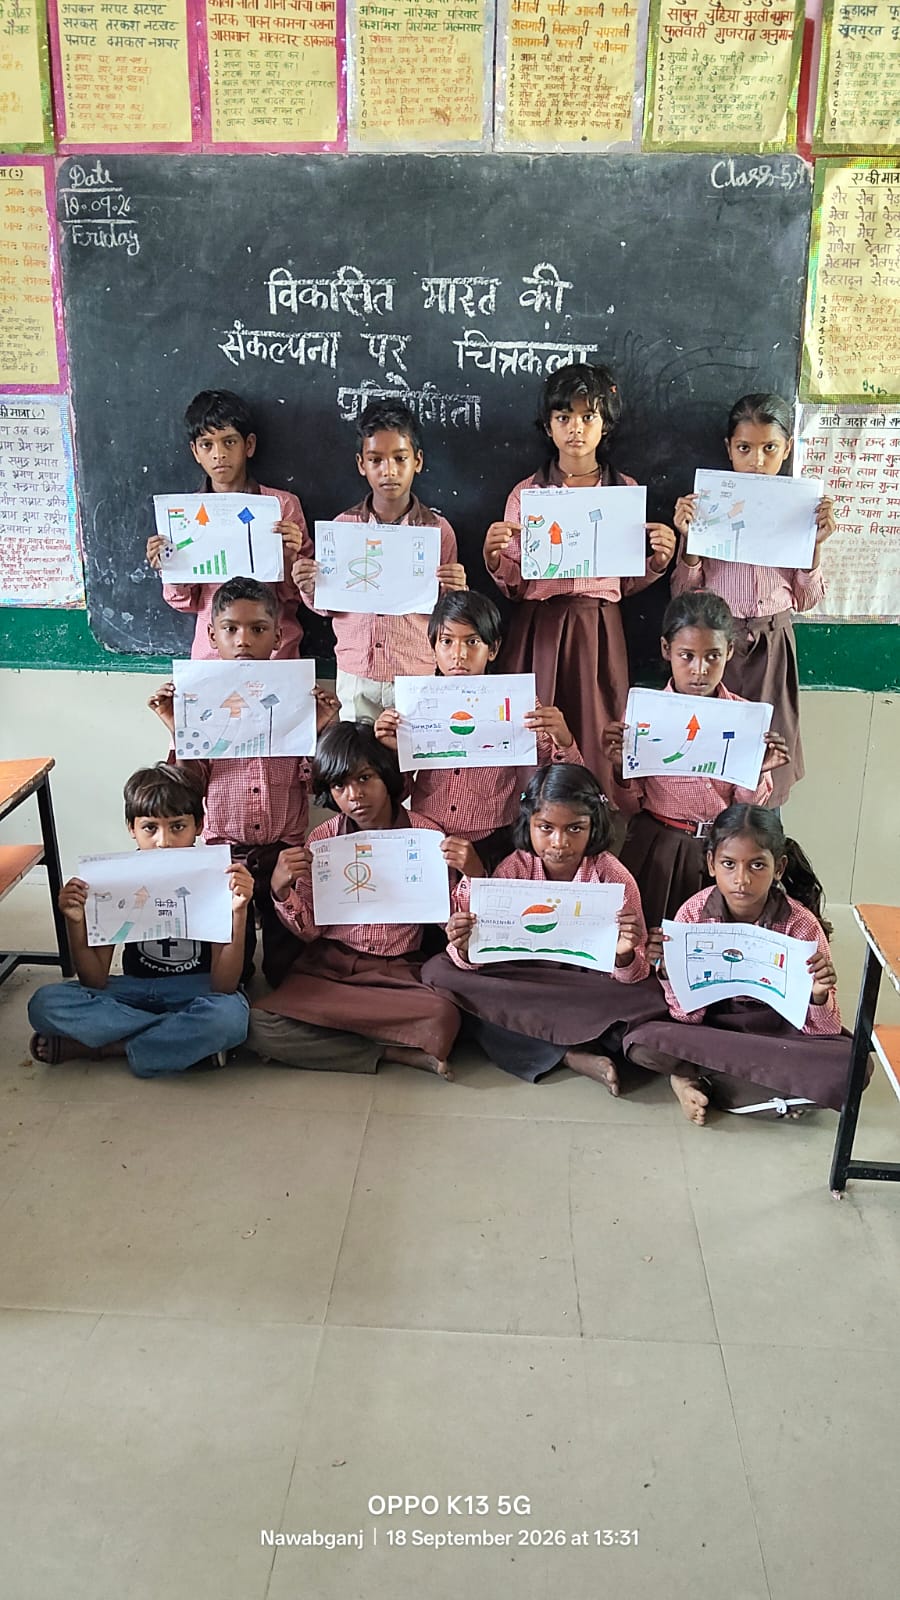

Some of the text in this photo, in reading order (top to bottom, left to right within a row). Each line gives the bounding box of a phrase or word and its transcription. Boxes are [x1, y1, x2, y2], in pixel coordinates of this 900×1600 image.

[133, 4, 166, 15] झटपट
[359, 2, 398, 17] अभिमान
[403, 5, 440, 19] नारियल
[447, 6, 480, 20] परिवार
[667, 7, 699, 25] साबुन
[705, 5, 743, 26] चुहिया
[743, 8, 769, 26] मुरली
[63, 18, 179, 32] सरकस तरकश नटखट
[209, 13, 239, 26] नाटक
[359, 18, 484, 33] किशमिश गिरगिट मिलनसार
[211, 30, 250, 42] आसमान
[661, 22, 794, 45] फुलवारी गुजरात अनुमान
[64, 34, 180, 50] पनघट दमकल नभचर
[69, 160, 113, 188] Date
[865, 169, 881, 185] की
[832, 186, 848, 204] शेर
[856, 188, 876, 205] सेब
[829, 206, 849, 220] मेला
[855, 206, 878, 222] नेता
[827, 222, 877, 240] मेरा मेघ
[72, 222, 140, 256] Friday
[827, 238, 894, 255] गणेश देवता
[825, 254, 860, 268] मेहमान
[519, 262, 573, 313] की
[821, 270, 862, 291] देहरादून
[218, 320, 598, 377] संकल्पना पर चित्रकला
[10, 408, 30, 418] मात्रा
[820, 414, 841, 426] आधे
[870, 414, 887, 427] वाले
[18, 438, 55, 453] प्रेम मुद्रा
[807, 448, 826, 461] रिक्त
[8, 456, 30, 469] समुद्र
[801, 465, 825, 475] हल्का
[828, 466, 851, 475] काव्य
[12, 470, 62, 480] भ्रमण प्रणाम
[828, 477, 853, 489] शक्ति
[859, 496, 882, 504] उत्तर
